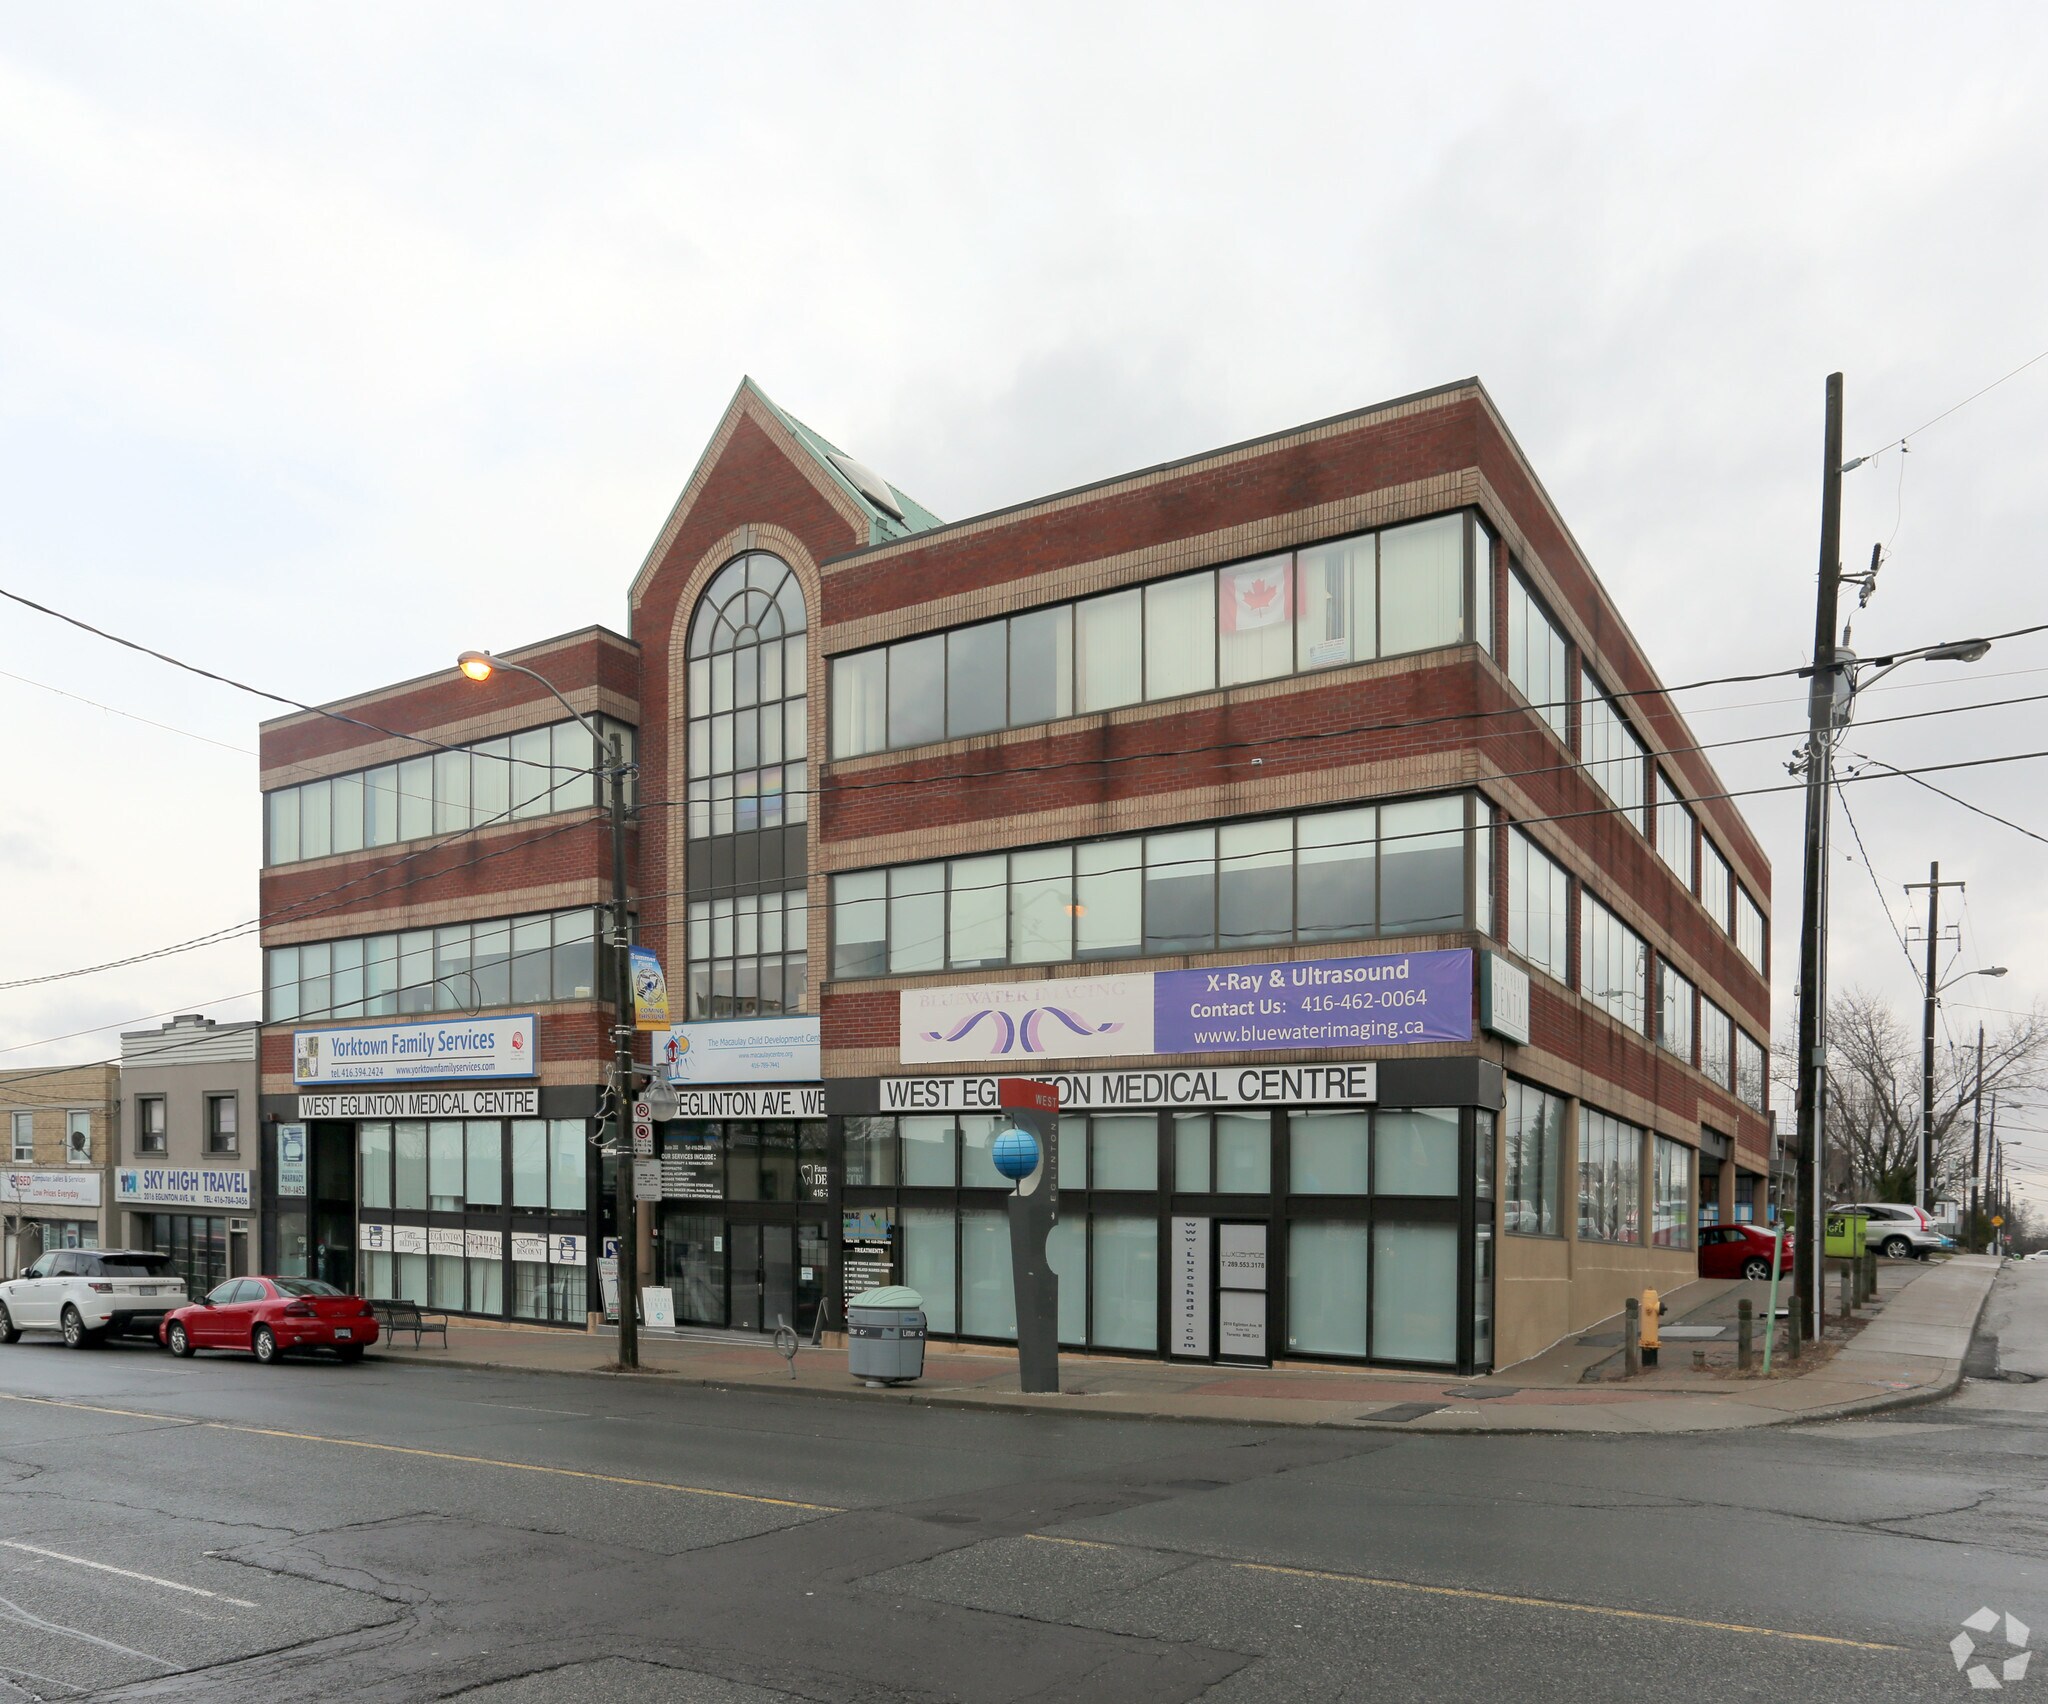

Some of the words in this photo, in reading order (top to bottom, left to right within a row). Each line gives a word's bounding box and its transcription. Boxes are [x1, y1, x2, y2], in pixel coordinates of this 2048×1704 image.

[1206, 971, 1263, 993] X-Ray
[1269, 969, 1285, 989] &
[1292, 959, 1409, 987] Ultrasound
[1190, 999, 1255, 1019] Contact
[1260, 998, 1286, 1014] Us:
[1301, 989, 1428, 1012] 416-462-0064
[331, 1036, 387, 1057] Yorktown
[392, 1033, 435, 1058] Family
[438, 1029, 495, 1052] Services
[708, 1038, 718, 1047] The
[720, 1036, 746, 1047] Macaulay
[748, 1036, 763, 1045] Child
[764, 1034, 805, 1045] Development
[1194, 1019, 1424, 1044] www.bluewaterimaging.ca
[396, 1062, 495, 1075] www.yorktownfamilyservices.com
[887, 1079, 954, 1108] WEST
[1102, 1071, 1228, 1105] MEDICAL
[1237, 1066, 1367, 1101] CENTRE
[302, 1096, 336, 1116] WEST
[340, 1094, 404, 1115] EGLINTON
[409, 1092, 469, 1114] MEDICAL
[474, 1091, 534, 1113] CENTRE
[679, 1092, 756, 1116] EGLINTON
[761, 1091, 795, 1115] AVE.
[1036, 1094, 1057, 1108] WEST
[144, 1170, 164, 1190] SKY
[168, 1171, 199, 1191] HIGH
[203, 1172, 247, 1193] TRAVEL
[44, 1189, 57, 1197] Prices
[58, 1190, 79, 1199] Everyday
[155, 1193, 178, 1202] EGLINTON
[1828, 1222, 1843, 1233] GFL
